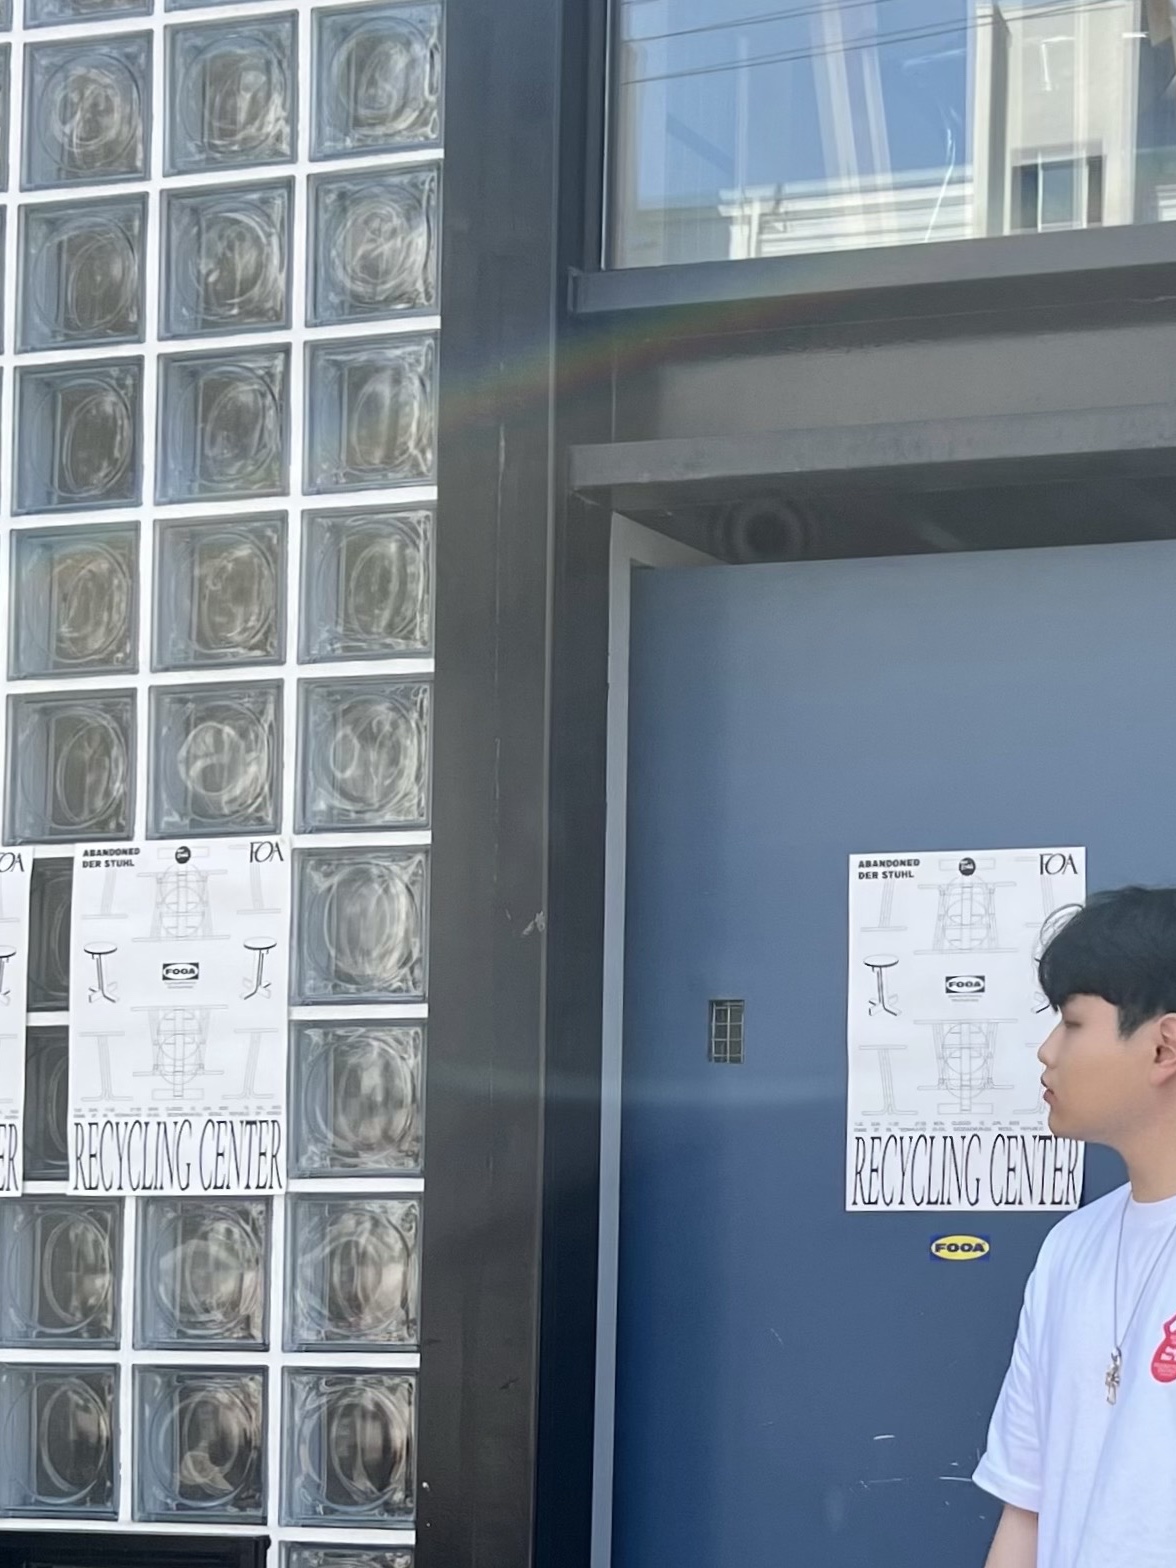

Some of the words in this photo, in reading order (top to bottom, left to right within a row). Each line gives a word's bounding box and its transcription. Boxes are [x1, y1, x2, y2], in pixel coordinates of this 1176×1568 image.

[82, 847, 141, 858] ABANDONED
[82, 859, 101, 869] DER
[104, 859, 135, 868] STUHL
[858, 858, 921, 869] ABANDONED
[858, 871, 878, 880] DER
[882, 870, 914, 880] STUHL
[73, 1119, 192, 1192] RECYCLING
[199, 1118, 283, 1191] CENTER
[852, 1133, 982, 1207] RECYCLING
[989, 1133, 1081, 1207] CENTER
[934, 1242, 986, 1253] FOOA
